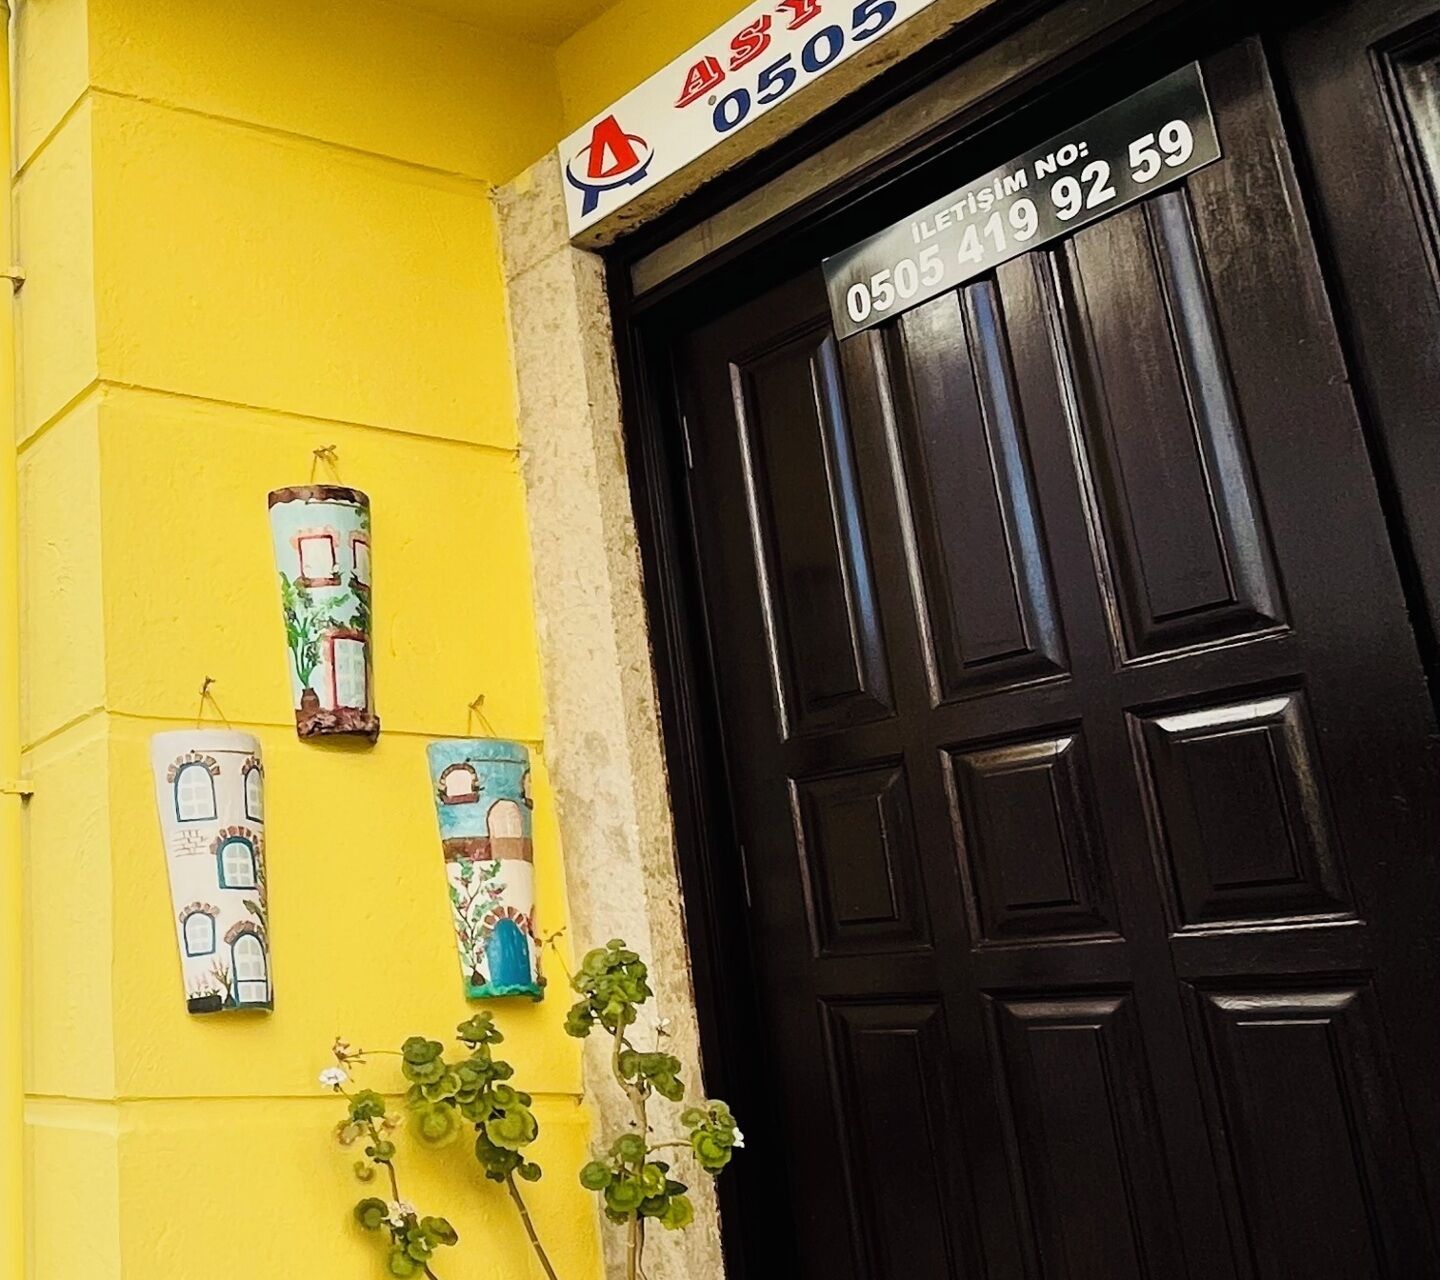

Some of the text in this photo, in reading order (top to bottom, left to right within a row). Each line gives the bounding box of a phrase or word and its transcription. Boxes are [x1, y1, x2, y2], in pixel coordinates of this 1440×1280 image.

[845, 118, 1194, 323] 0505 419 92 59
[910, 140, 1090, 244] İLETİŞİM NO:
